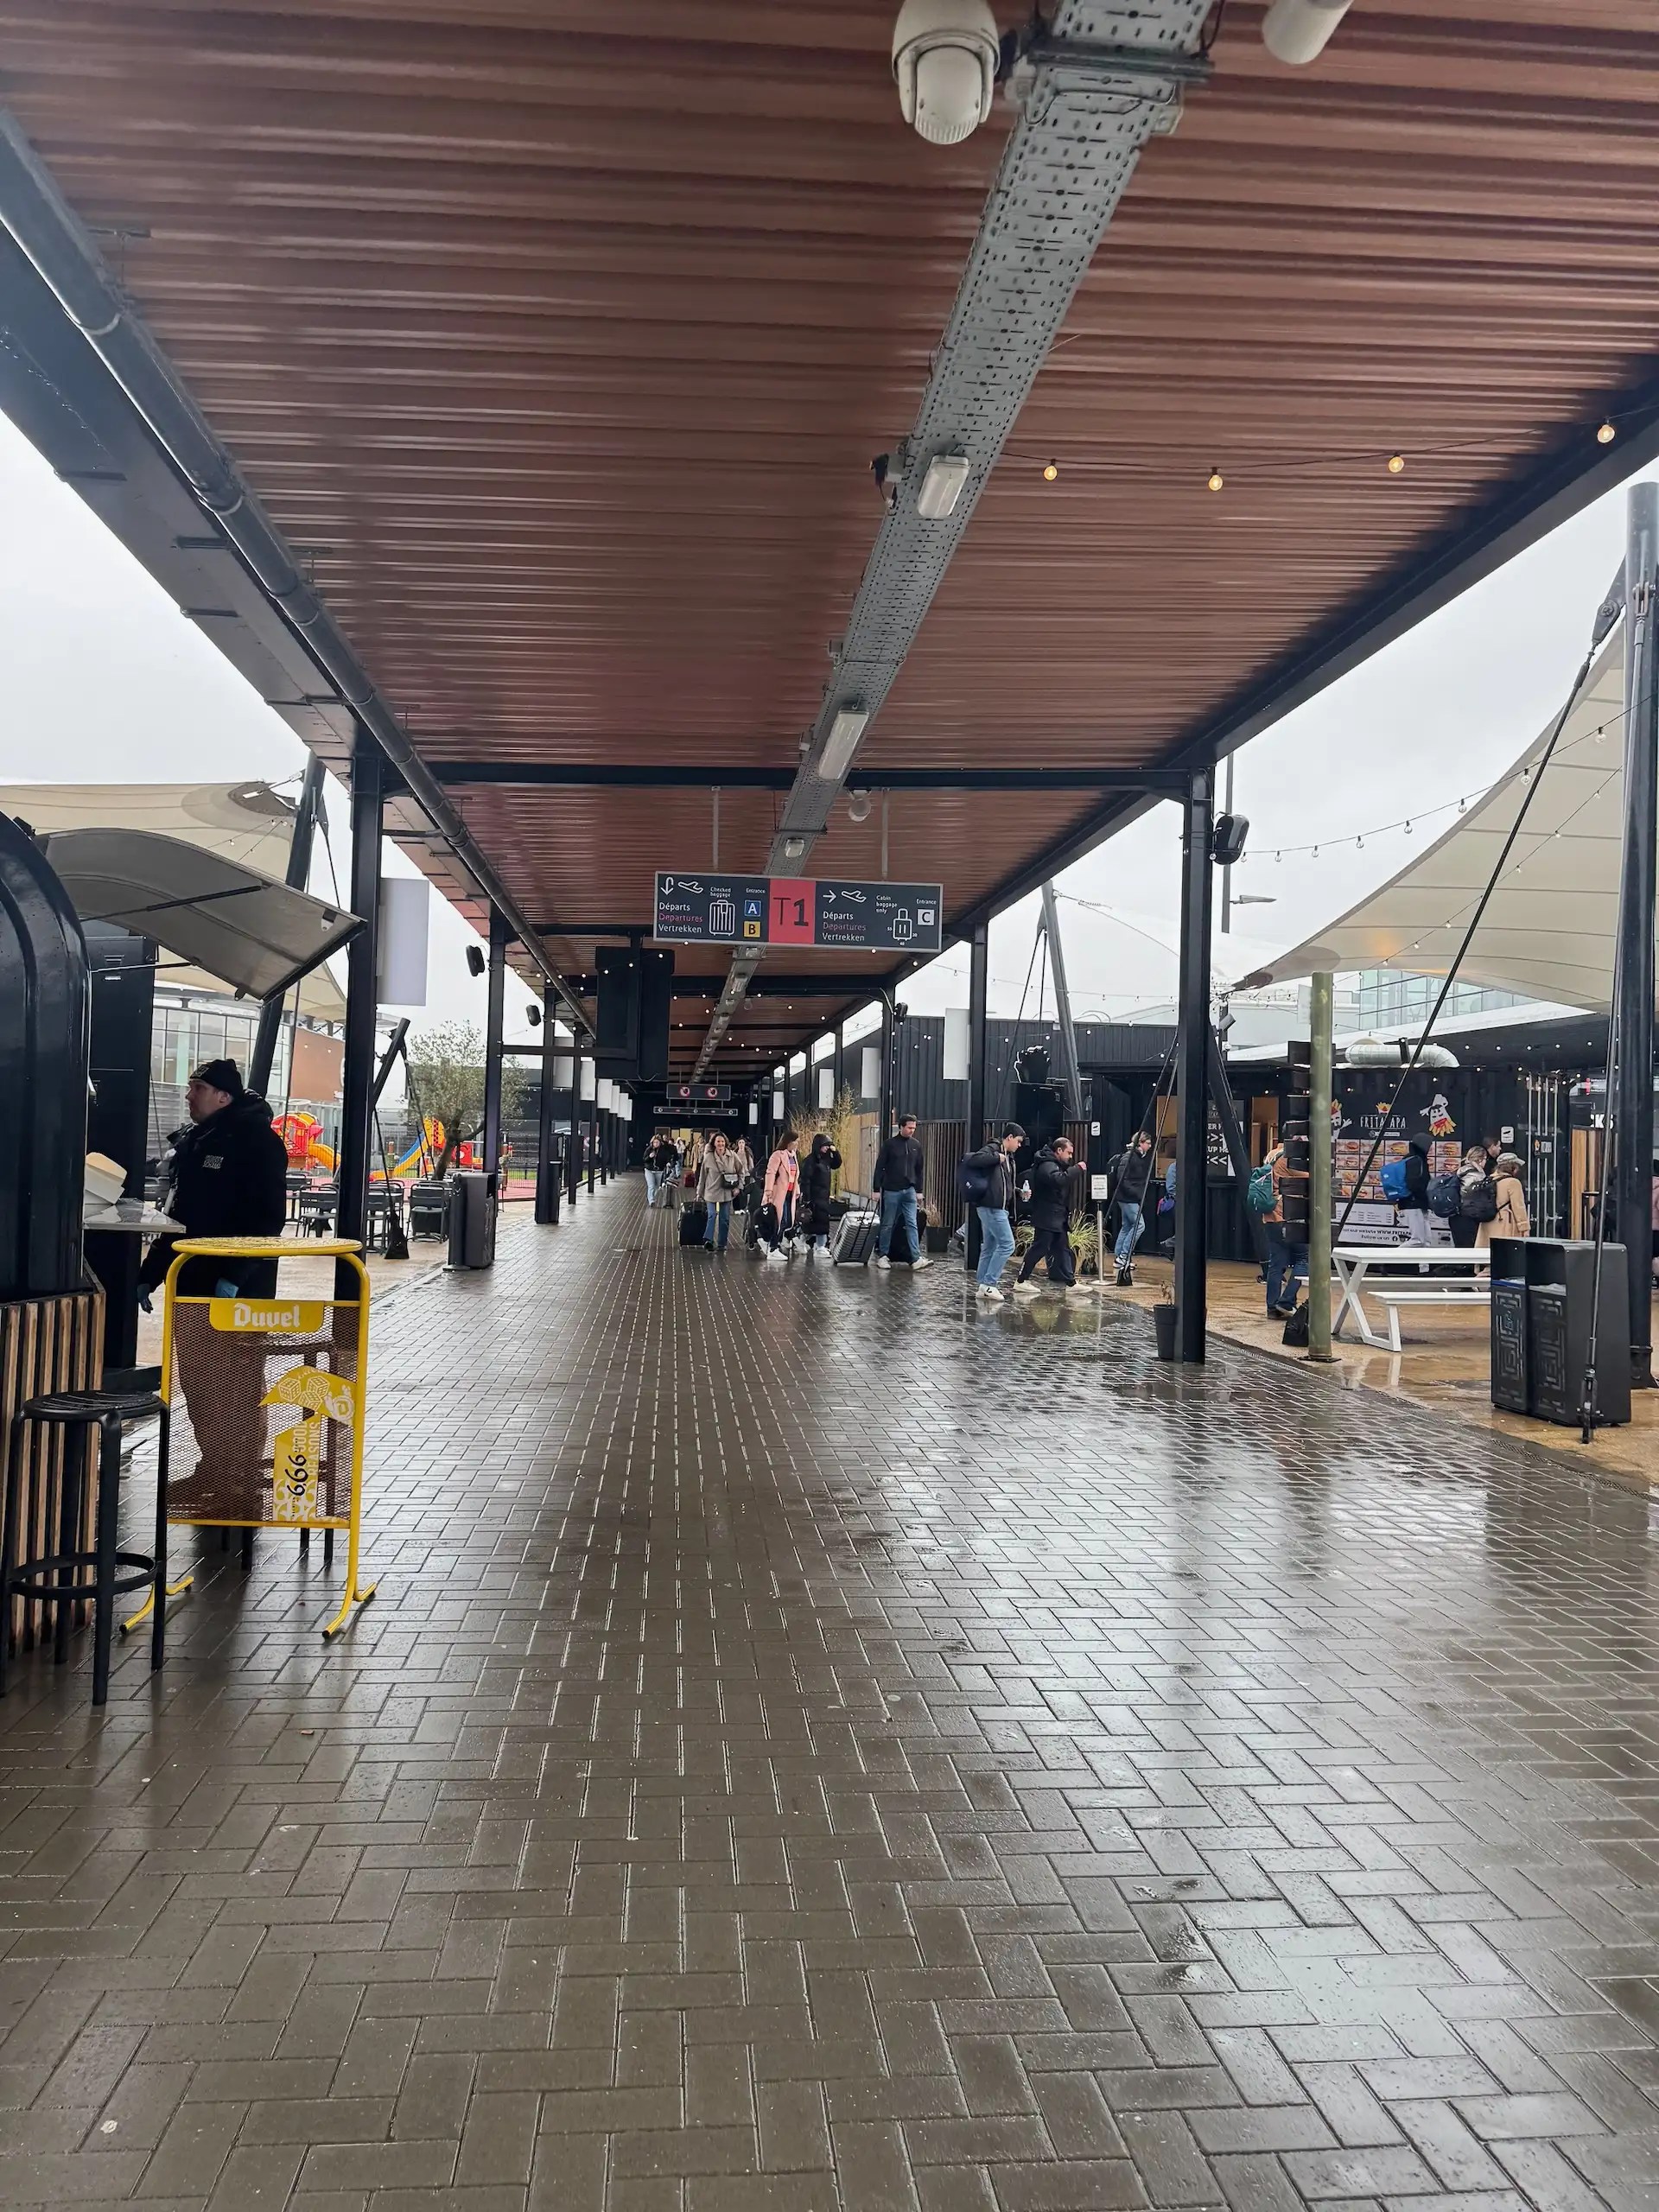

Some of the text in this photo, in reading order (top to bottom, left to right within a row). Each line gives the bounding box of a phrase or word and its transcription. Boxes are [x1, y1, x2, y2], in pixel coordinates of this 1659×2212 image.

[658, 902, 691, 912] Départs
[747, 902, 758, 915] A
[772, 897, 810, 927] T1
[658, 912, 703, 923] Departures
[823, 911, 854, 921] Départs
[921, 912, 931, 923] C
[658, 923, 702, 933] Vertrekken
[748, 924, 756, 935] B
[823, 921, 867, 931] Departures
[822, 932, 865, 942] Vertrekken
[233, 1302, 301, 1328] Duvel
